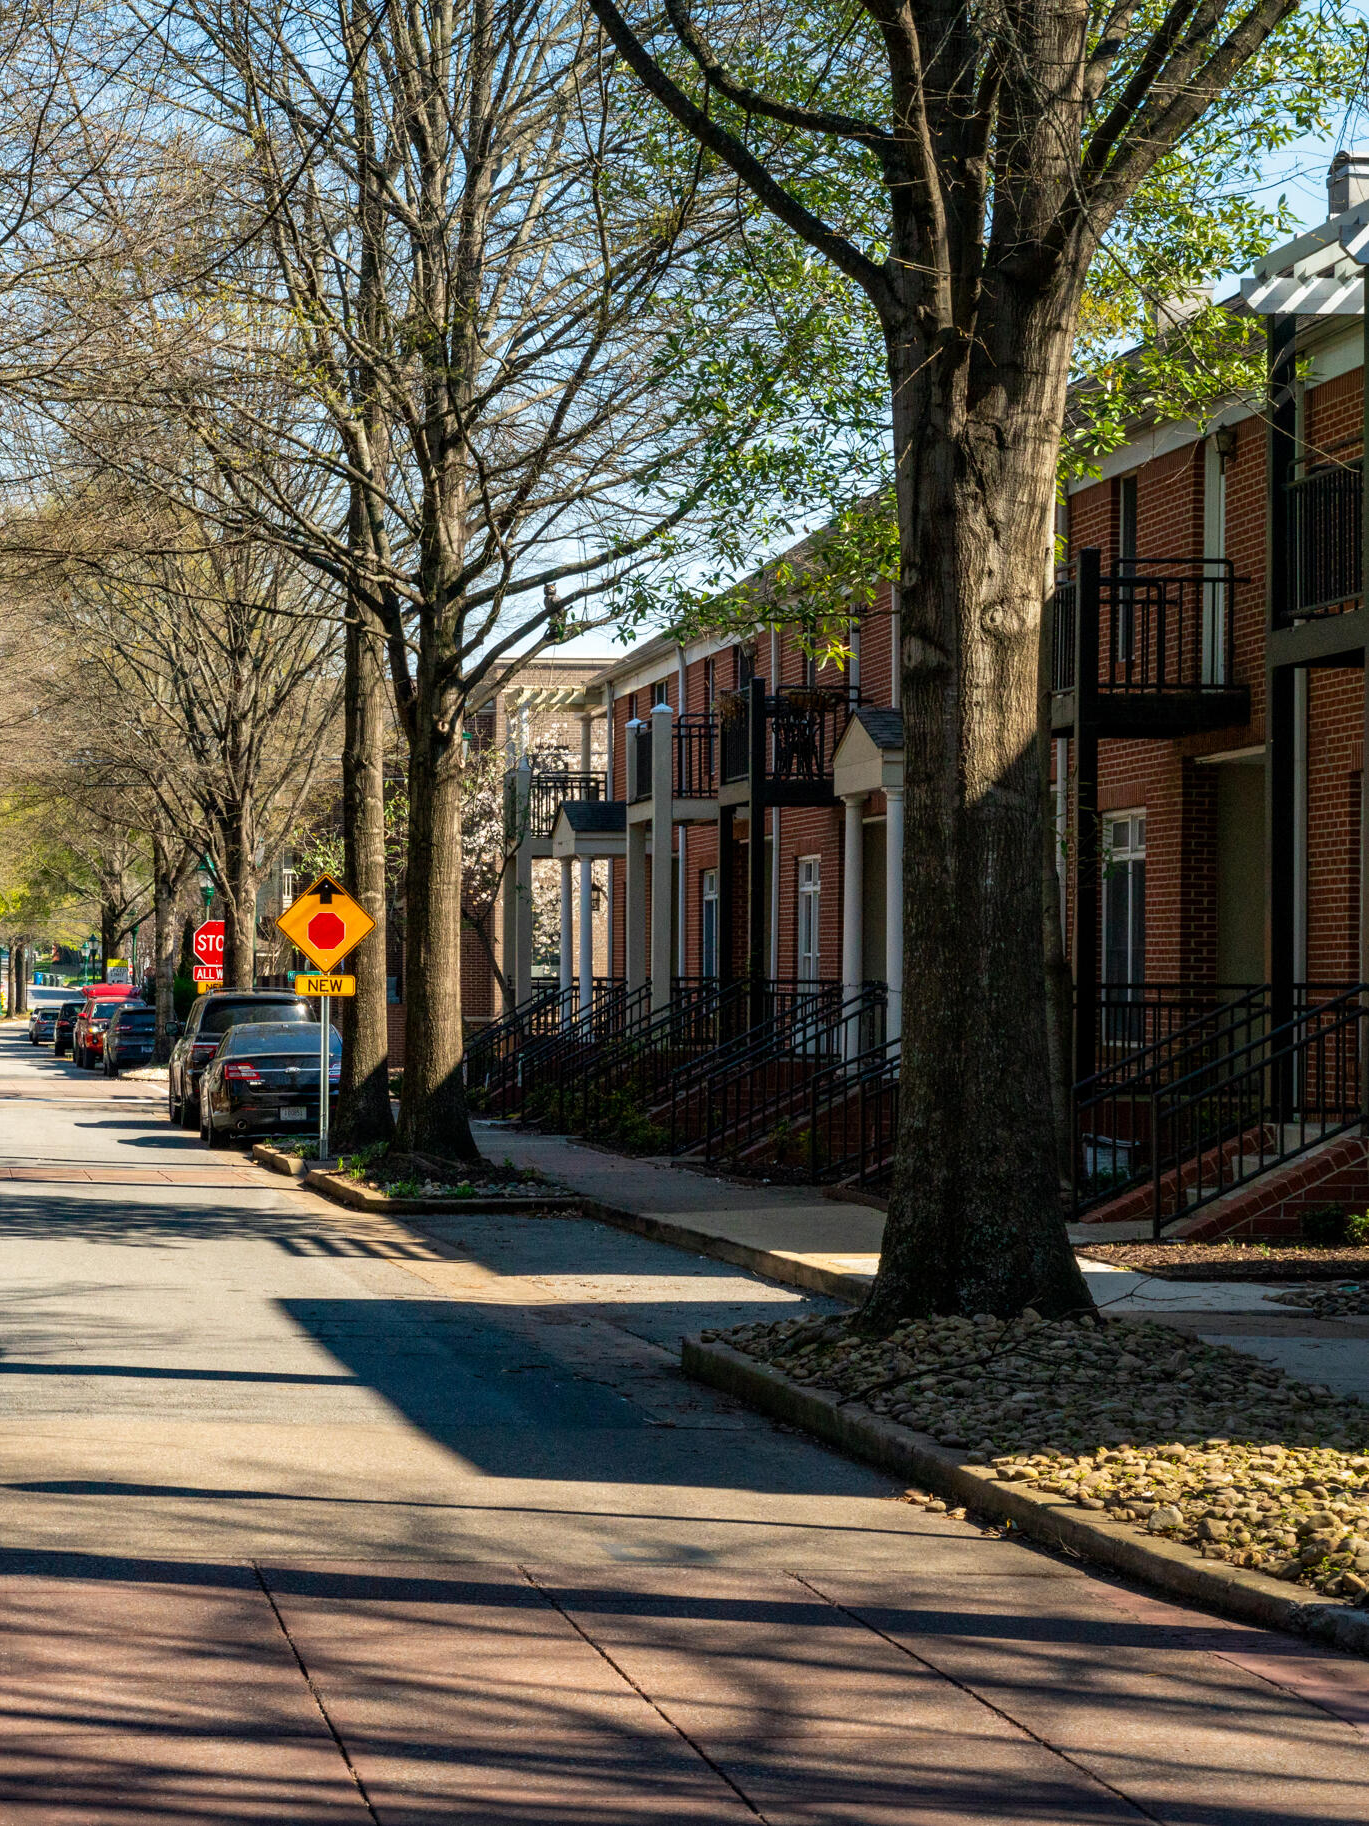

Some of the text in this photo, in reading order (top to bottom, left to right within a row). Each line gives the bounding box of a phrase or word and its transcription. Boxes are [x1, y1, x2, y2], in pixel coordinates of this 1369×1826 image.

[197, 934, 224, 951] STO
[197, 968, 215, 979] ALL
[308, 979, 343, 992] NEW
